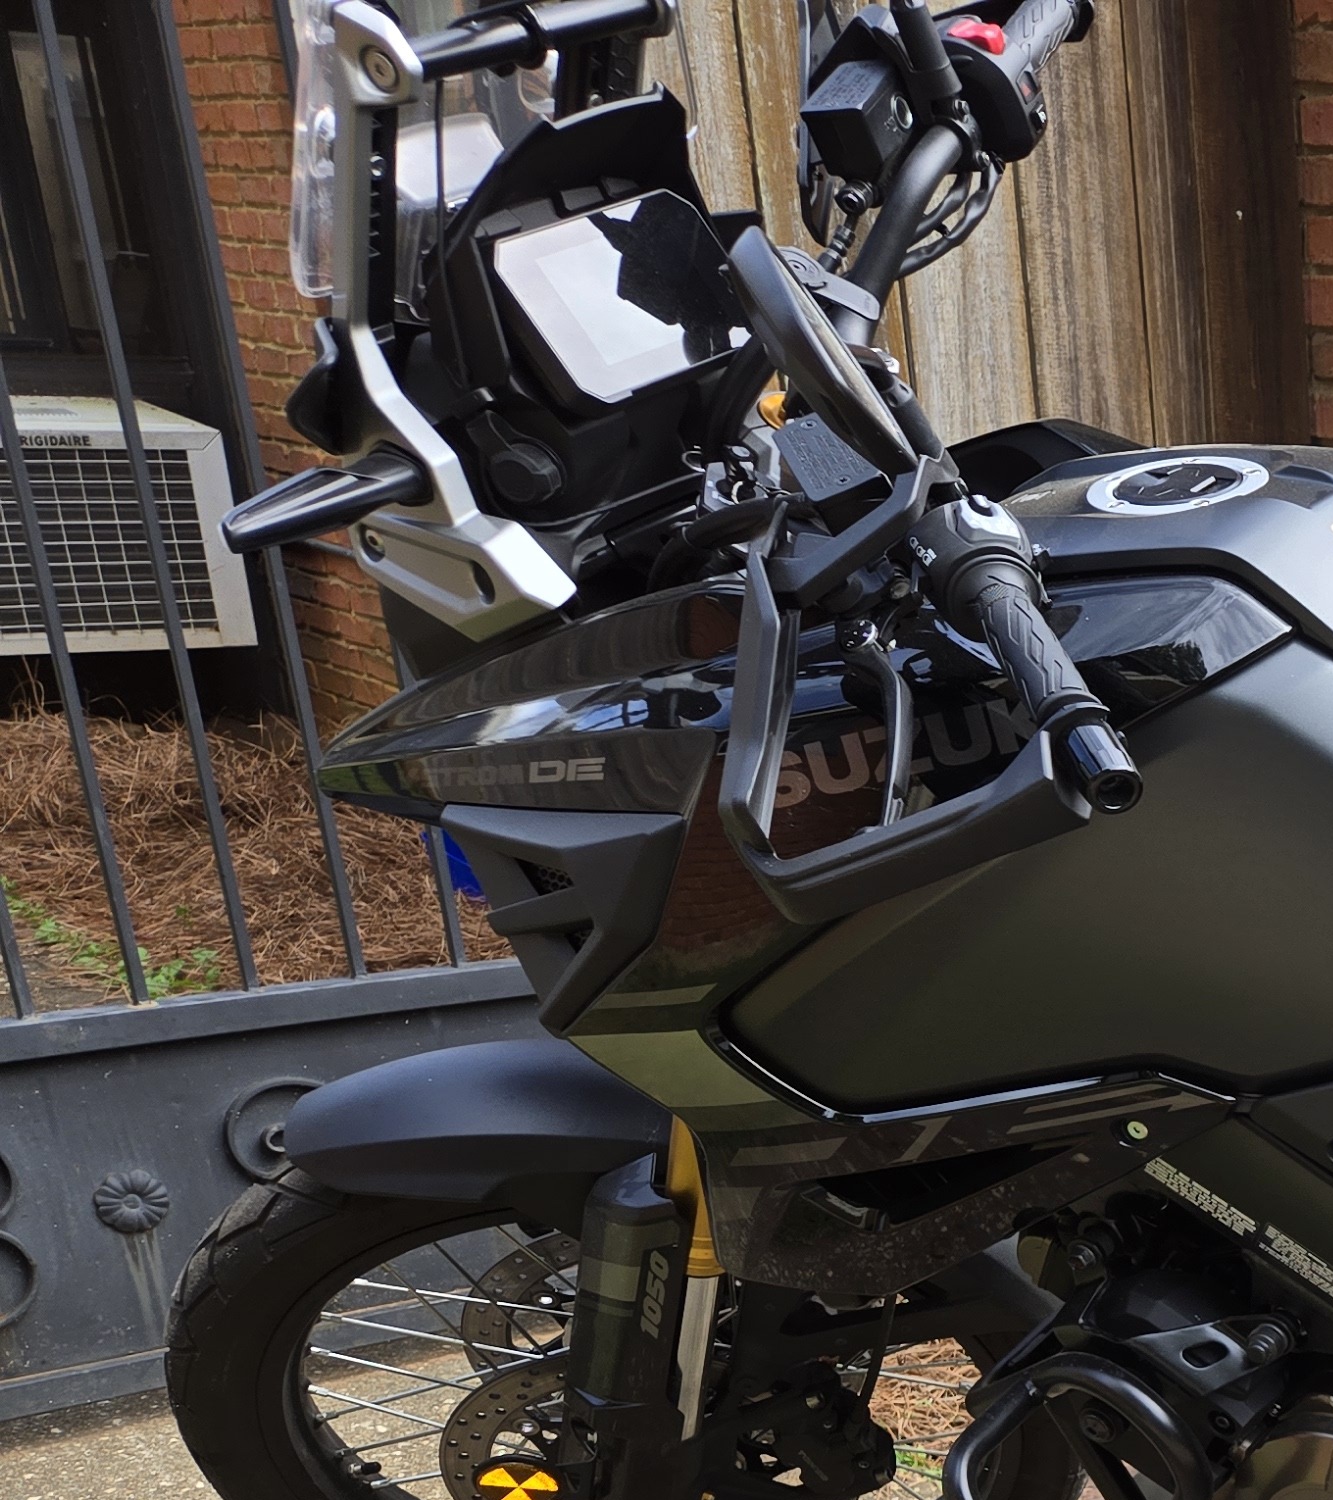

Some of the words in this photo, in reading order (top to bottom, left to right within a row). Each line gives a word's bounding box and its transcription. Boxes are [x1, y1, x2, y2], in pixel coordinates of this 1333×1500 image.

[18, 435, 91, 447] RIGIDAIRE
[529, 757, 606, 783] DE
[640, 1250, 669, 1339] 1050
